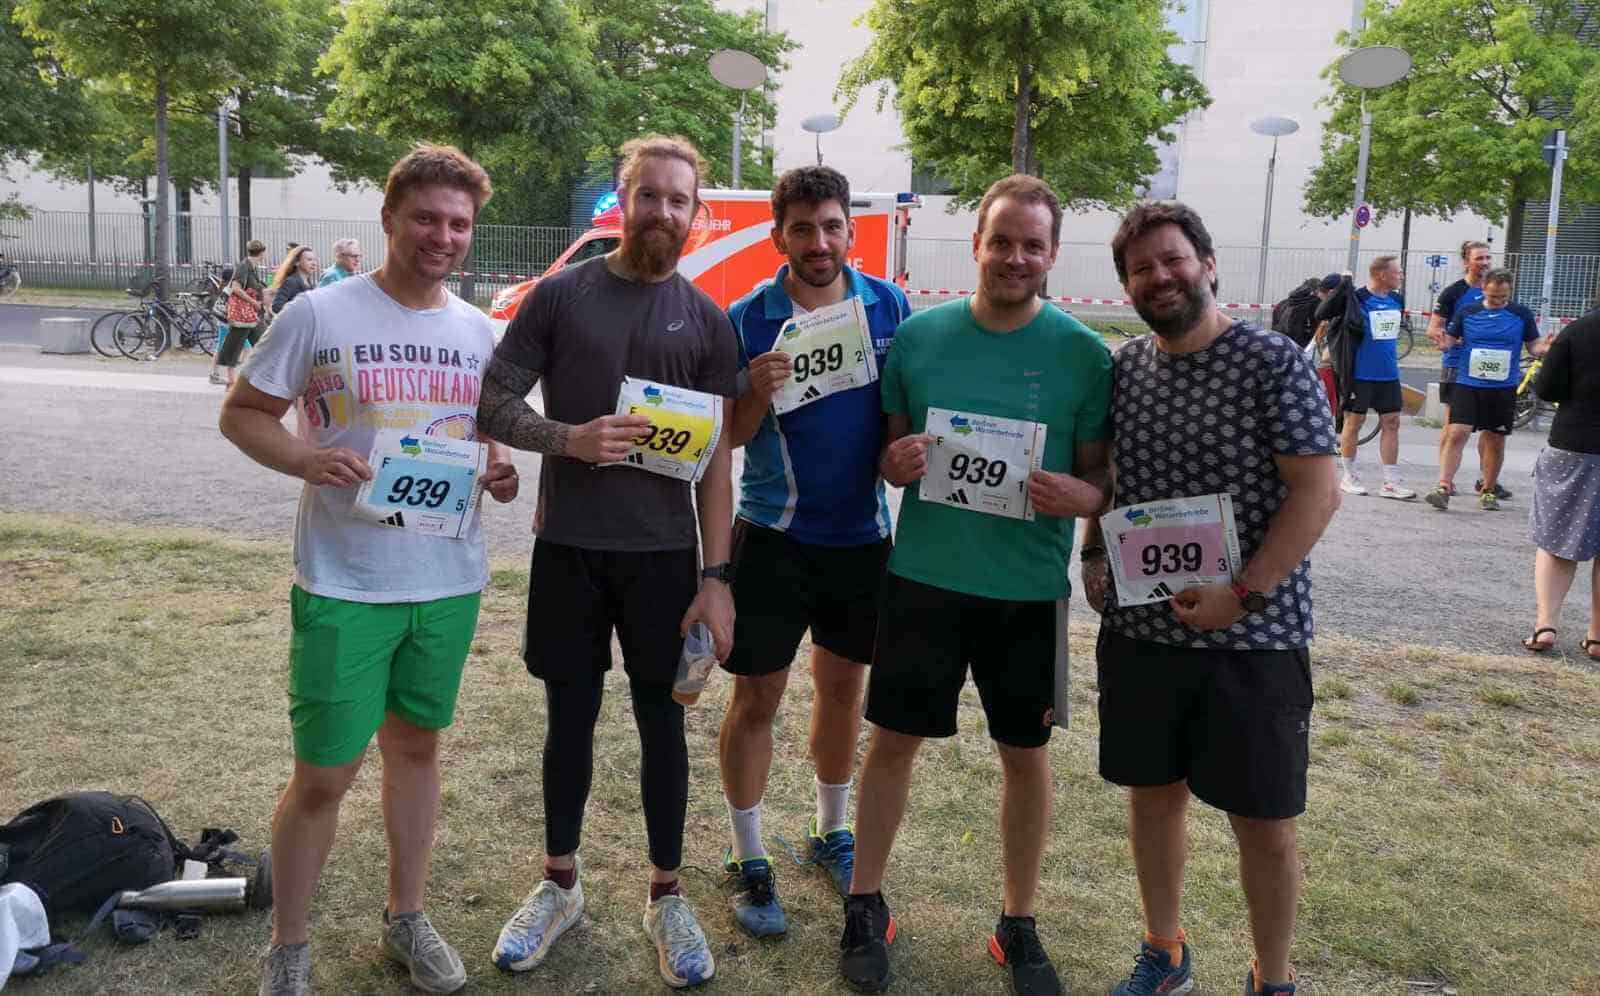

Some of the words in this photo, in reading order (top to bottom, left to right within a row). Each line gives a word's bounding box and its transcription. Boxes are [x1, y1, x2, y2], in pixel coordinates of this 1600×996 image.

[691, 217, 732, 231] ERWEHR
[354, 343, 383, 364] EU
[389, 343, 432, 364] SOU
[438, 347, 462, 368] DA
[854, 350, 864, 362] 2
[792, 342, 844, 384] 939
[1478, 360, 1501, 373] 398
[357, 366, 480, 407] DEUTSCHLAND
[630, 406, 638, 415] F
[936, 436, 945, 447] F
[693, 448, 702, 459] 4
[382, 457, 392, 469] F
[948, 453, 1007, 488] 939
[387, 475, 451, 509] 939
[1017, 481, 1024, 493] 1
[455, 499, 465, 512] 5
[1119, 532, 1127, 545] F
[1142, 542, 1203, 576] 939
[1217, 558, 1228, 572] 3
